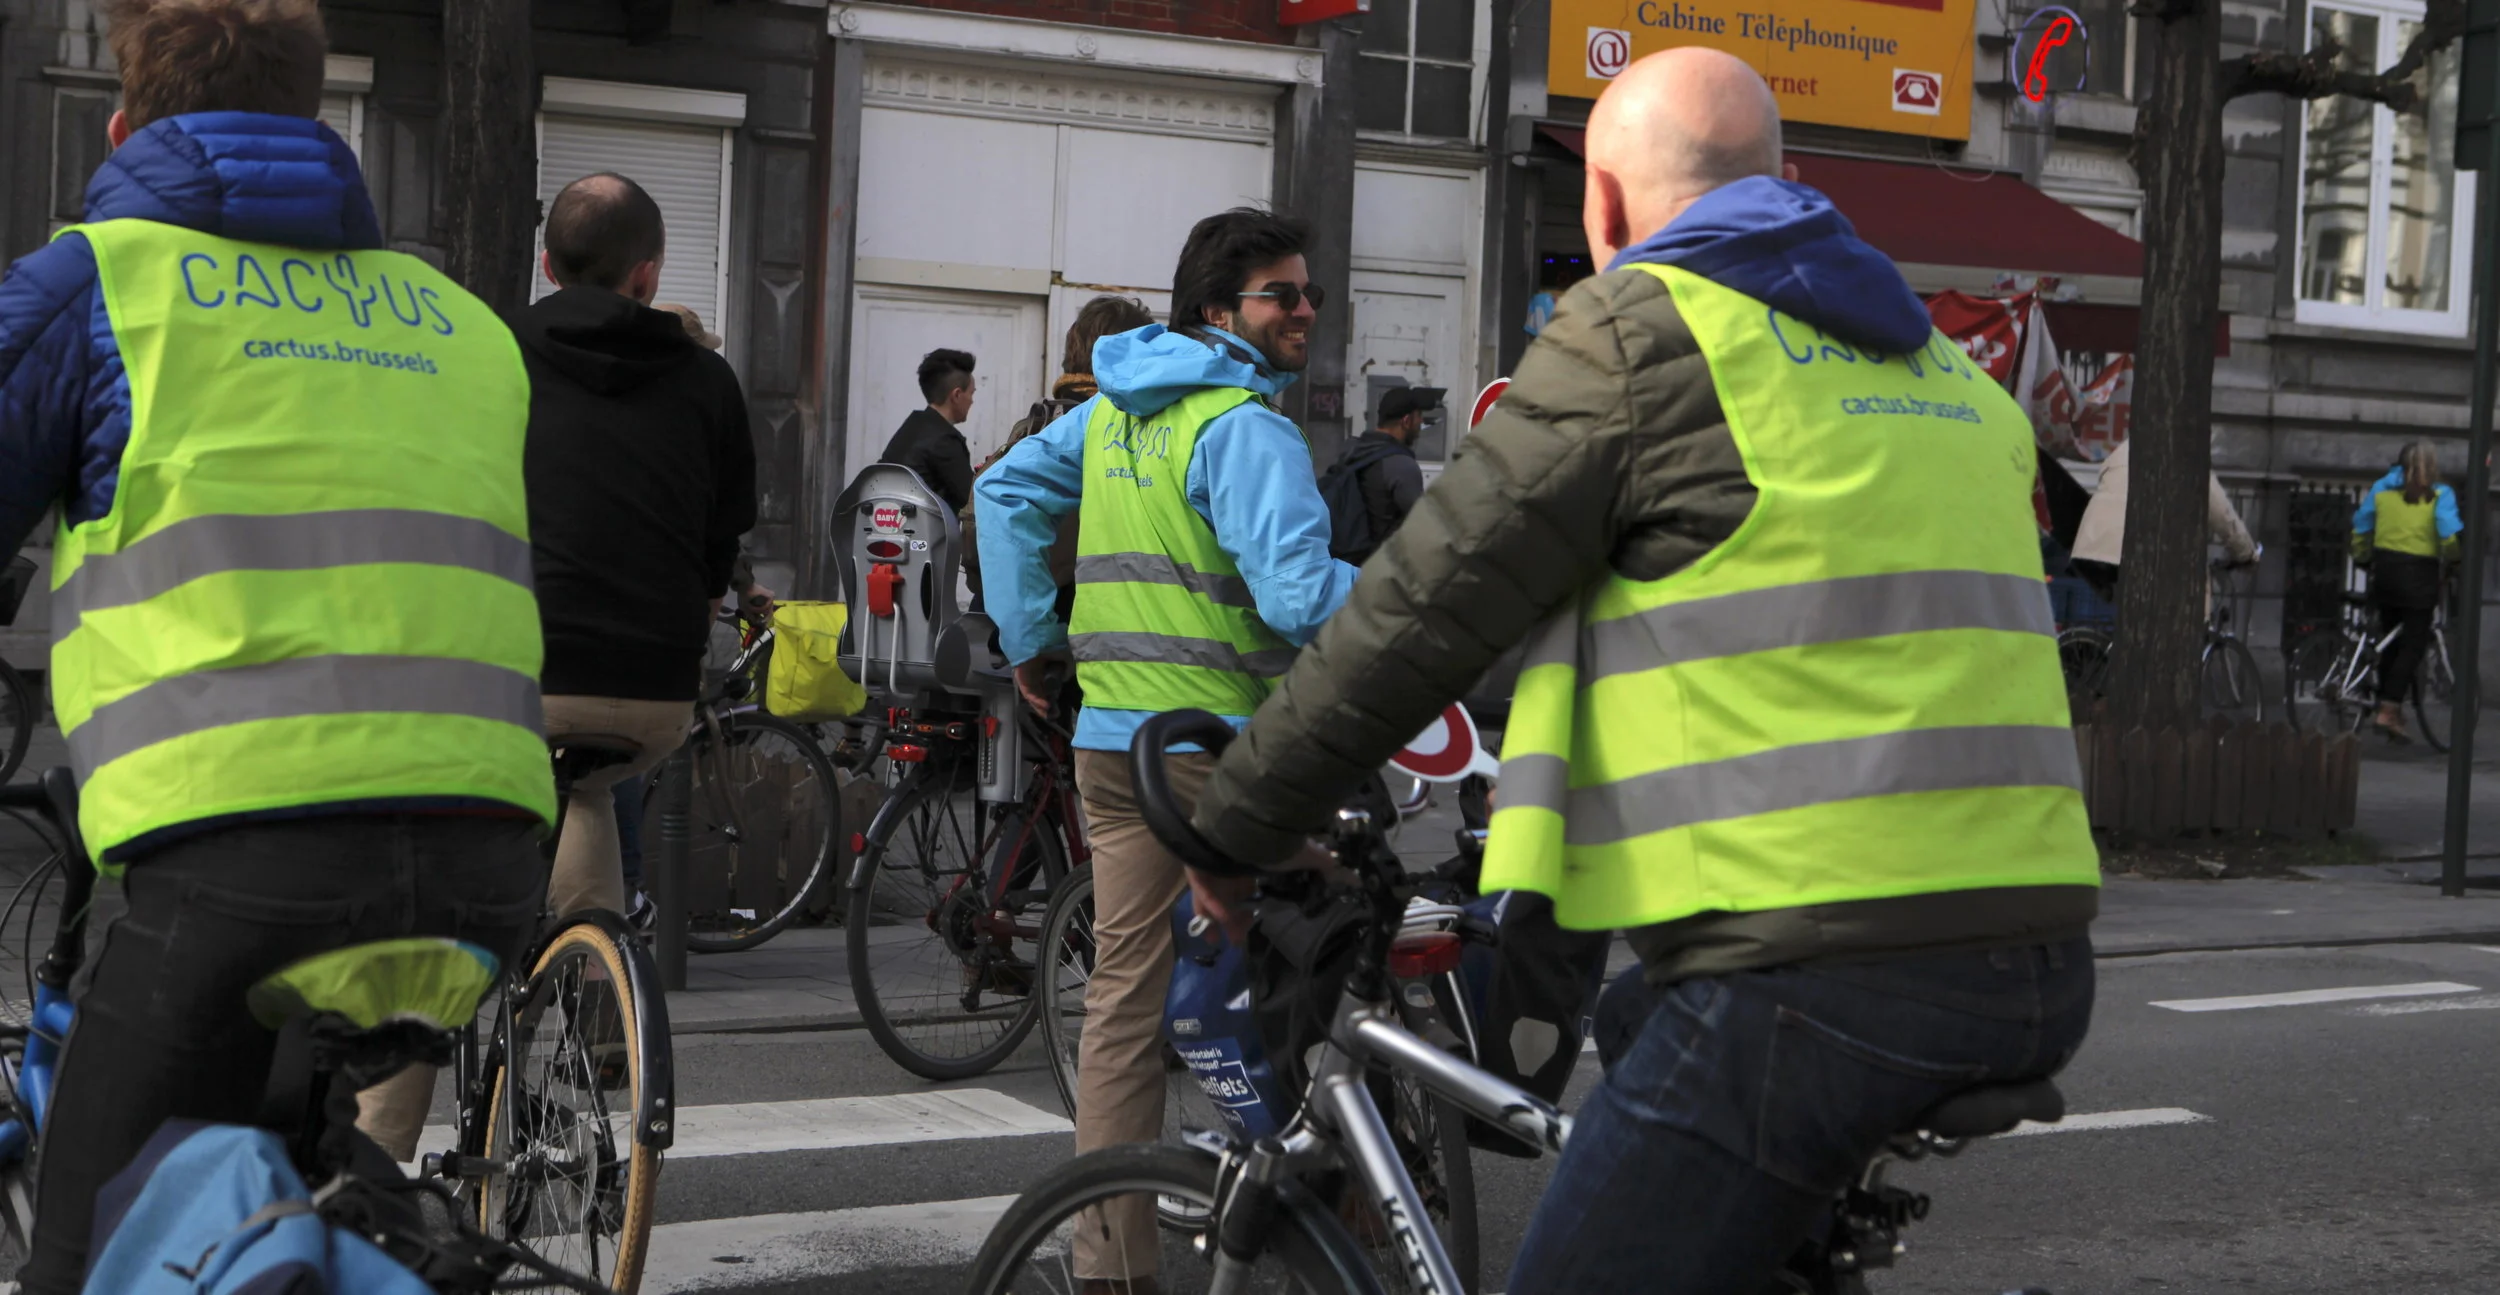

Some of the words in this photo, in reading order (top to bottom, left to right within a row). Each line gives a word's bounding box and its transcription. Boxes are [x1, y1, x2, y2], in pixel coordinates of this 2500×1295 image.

[1637, 1, 1726, 35] Cabine
[1737, 12, 1898, 60] Téléphonique
[181, 253, 454, 336] CACTUS
[243, 338, 438, 375] cactus.brussels
[876, 514, 896, 522] BABY
